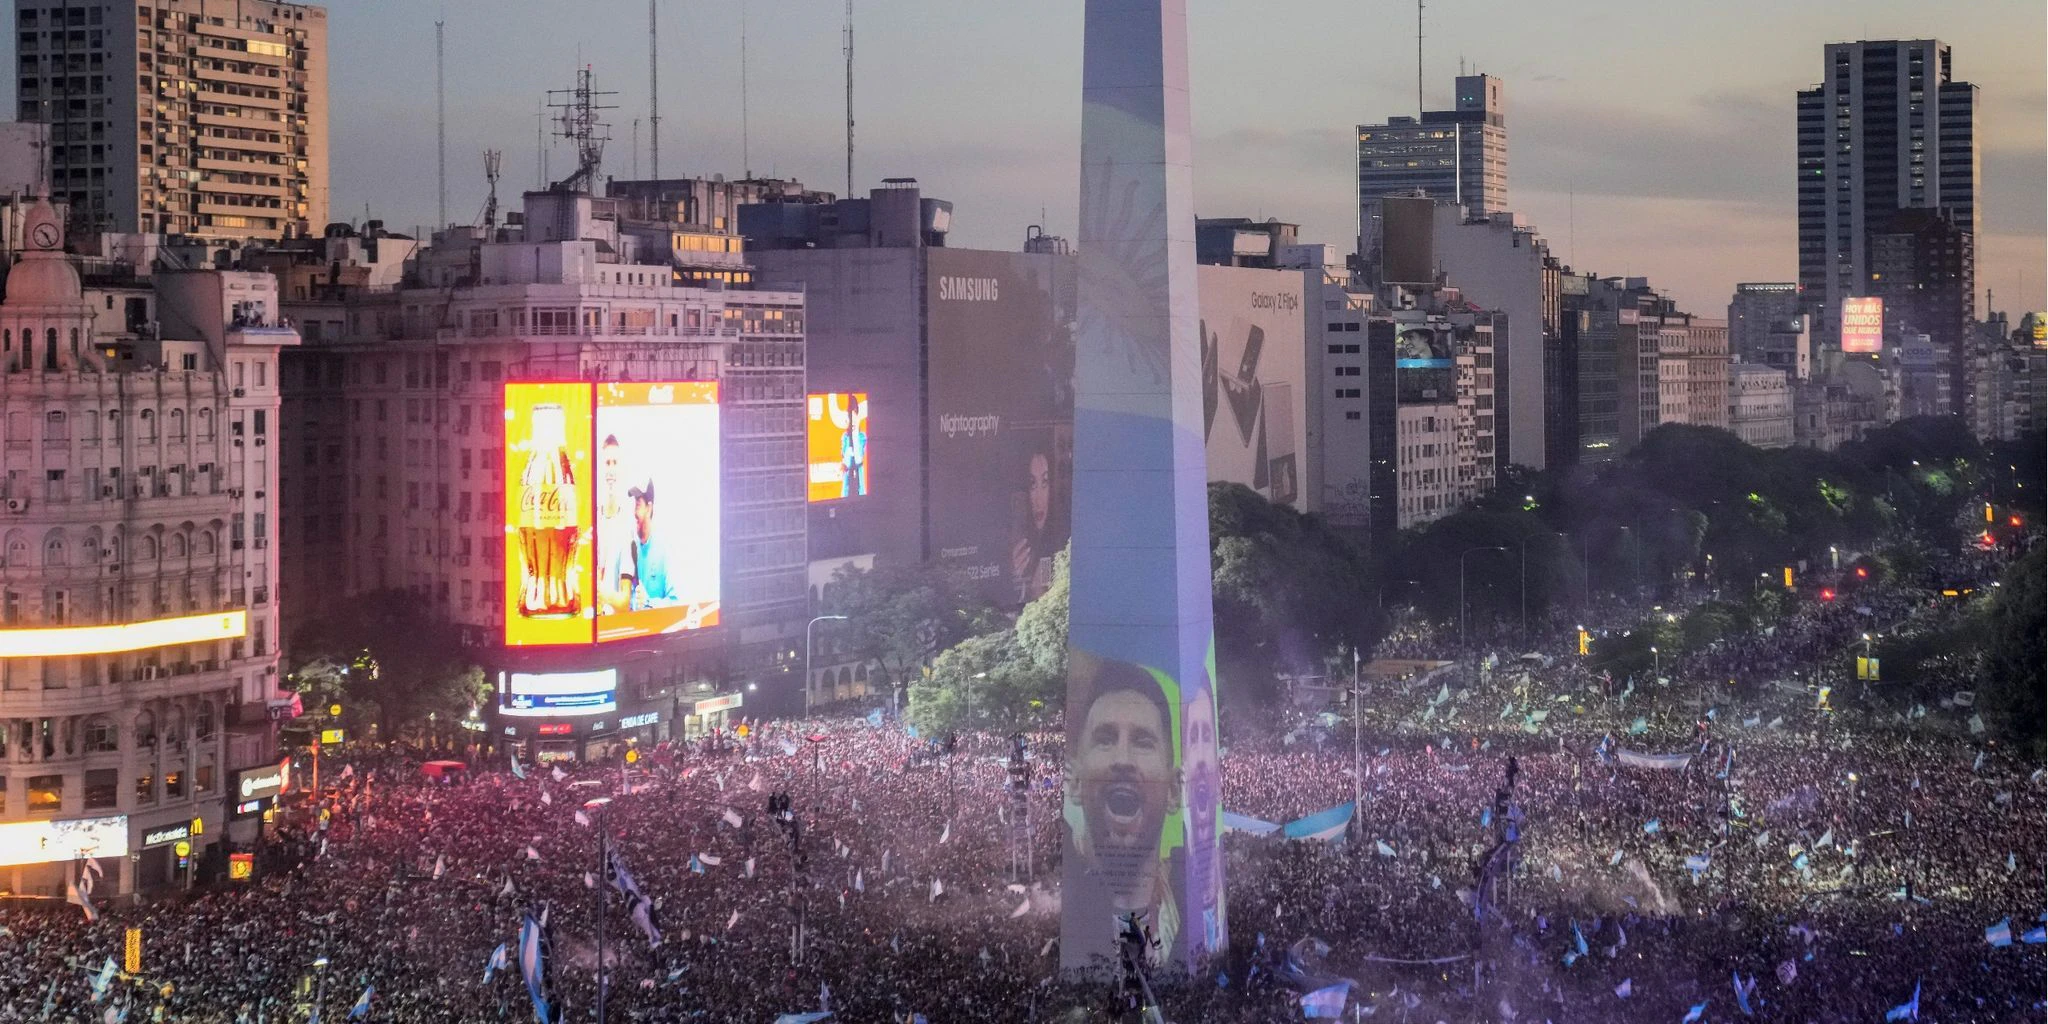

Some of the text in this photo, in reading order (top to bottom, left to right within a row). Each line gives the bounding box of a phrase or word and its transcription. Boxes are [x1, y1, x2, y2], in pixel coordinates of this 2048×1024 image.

[939, 276, 998, 301] SAMSUNG
[1251, 291, 1298, 316] Galaxy Z Flip4
[1845, 302, 1881, 313] HOY MÁS
[1844, 314, 1880, 326] UNIDOS
[1843, 326, 1880, 335] QUE NUNCA
[940, 413, 999, 438] Nightography
[980, 562, 1000, 579] Series
